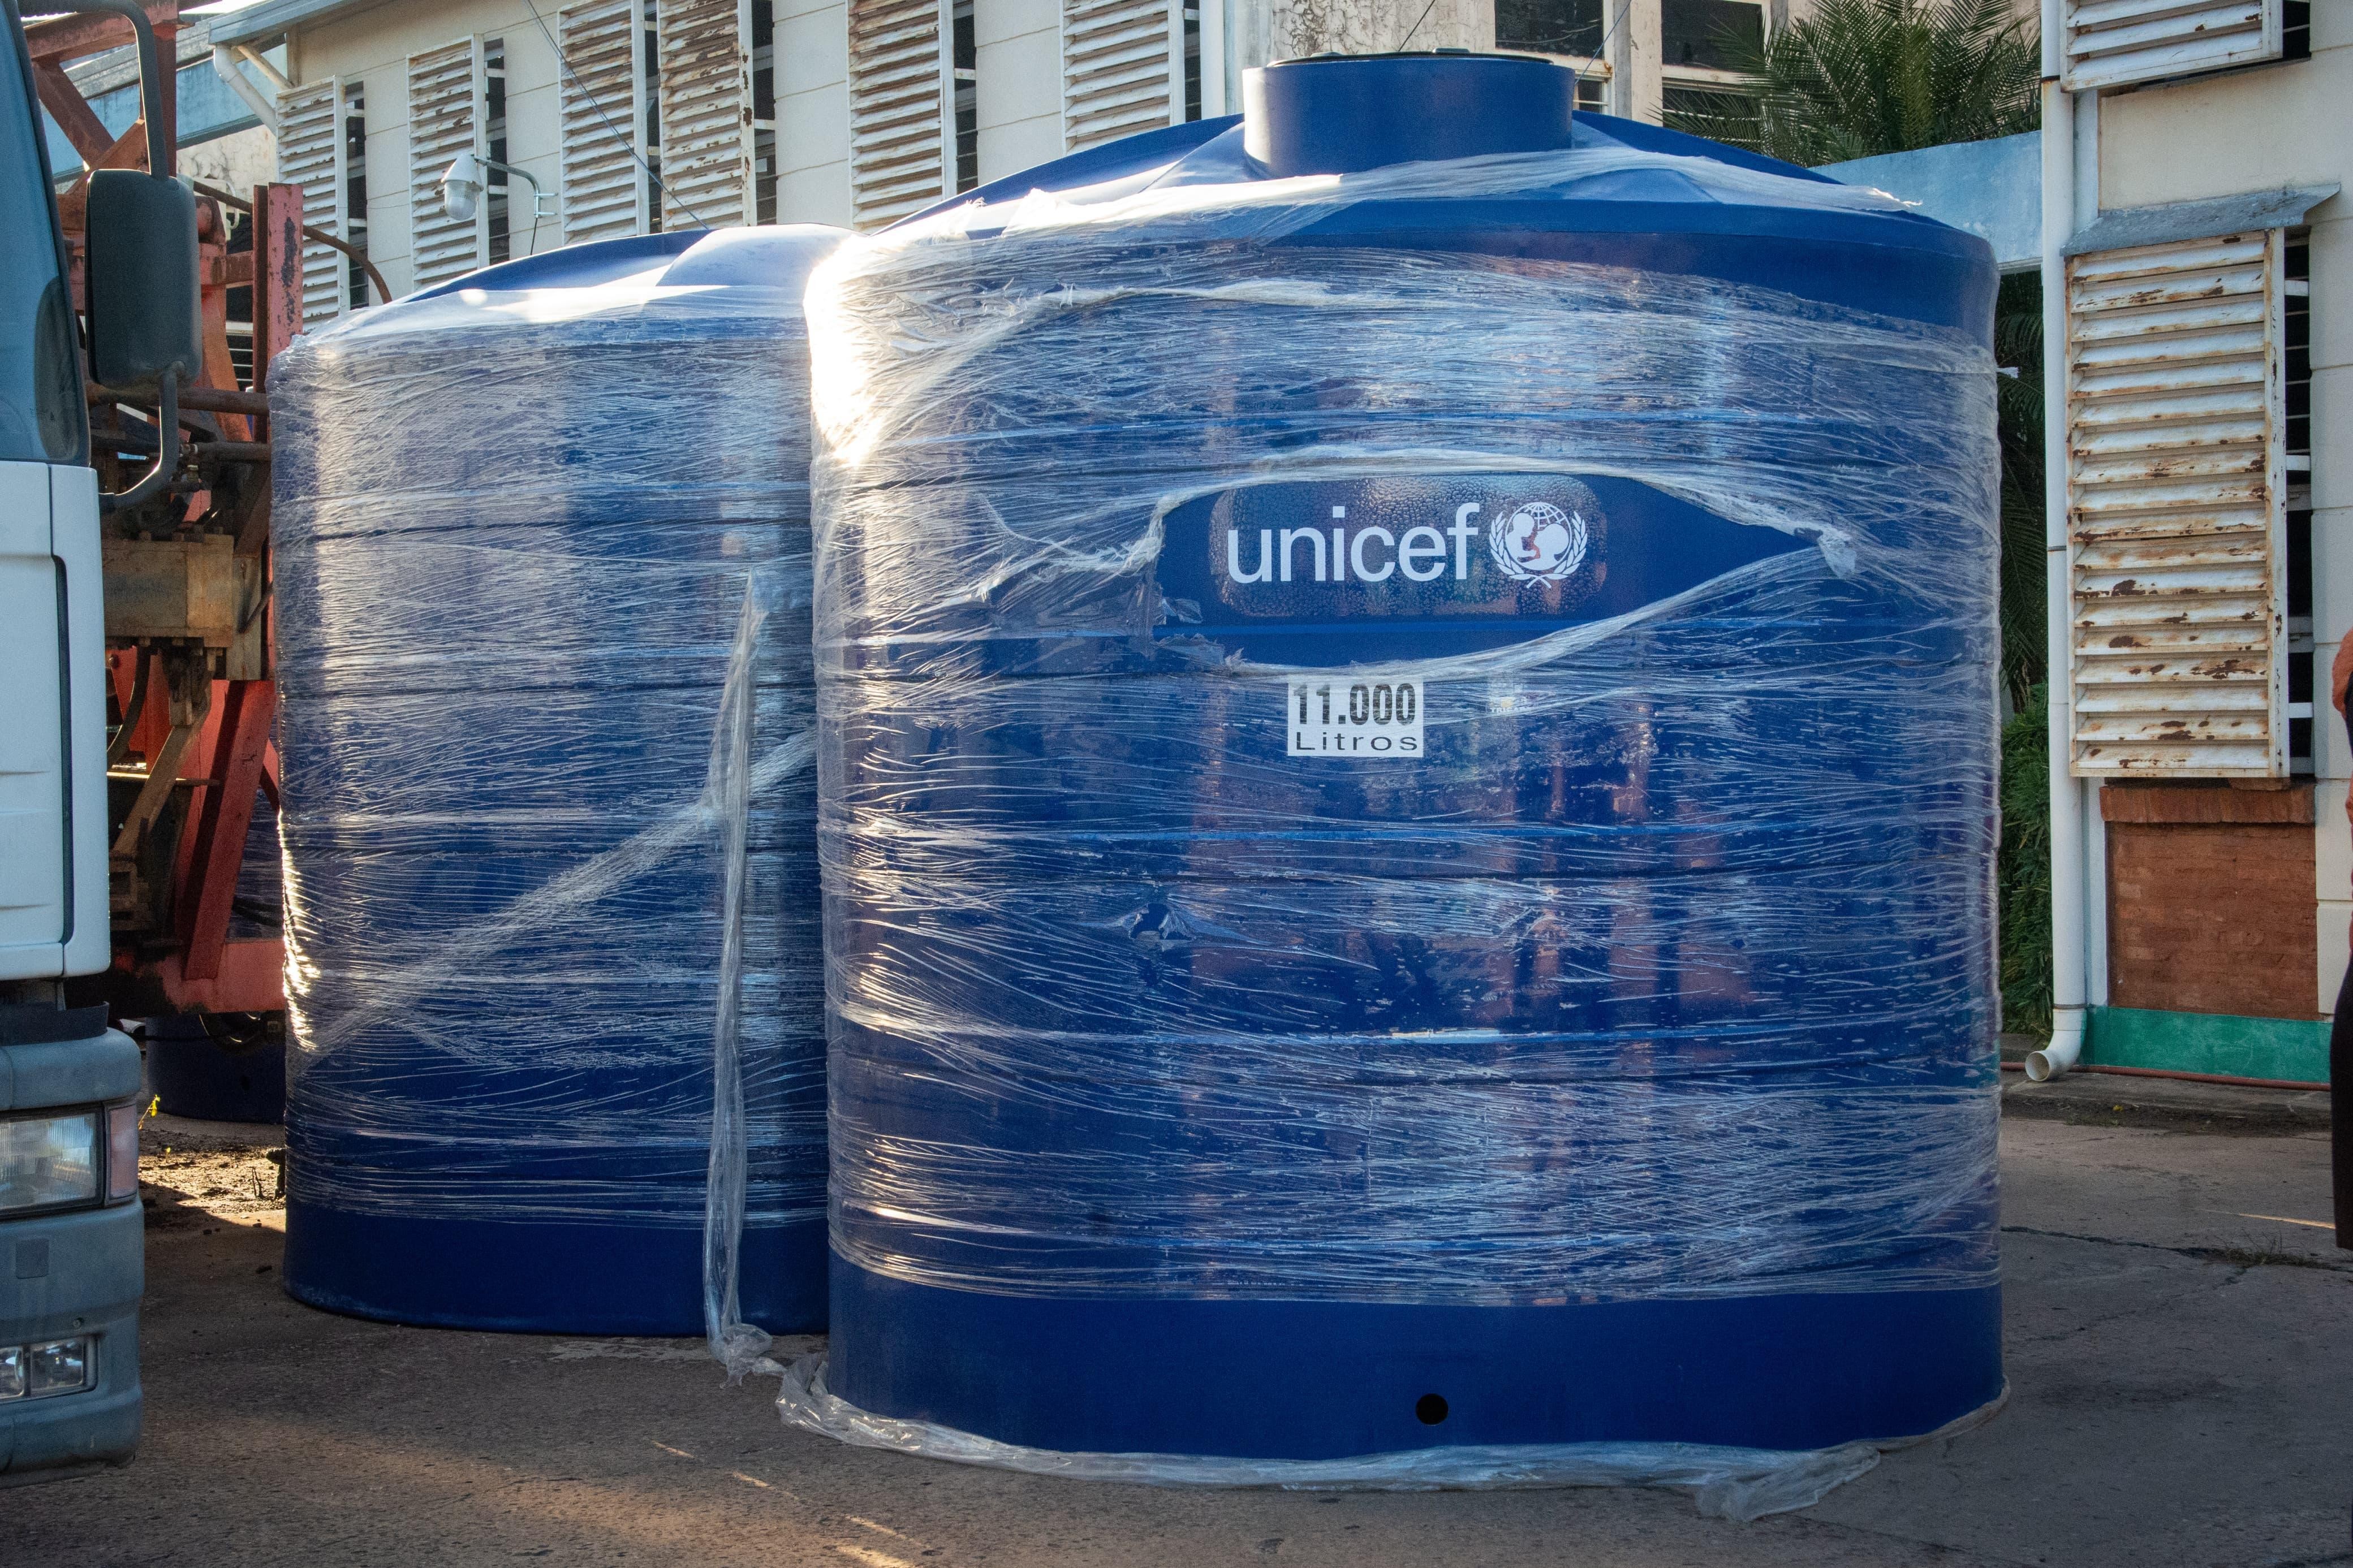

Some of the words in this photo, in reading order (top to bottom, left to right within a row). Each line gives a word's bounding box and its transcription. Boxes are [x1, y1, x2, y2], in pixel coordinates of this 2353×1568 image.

[1227, 502, 1480, 584] unicef
[1294, 683, 1416, 725] 11.000
[1296, 731, 1417, 751] Litros
